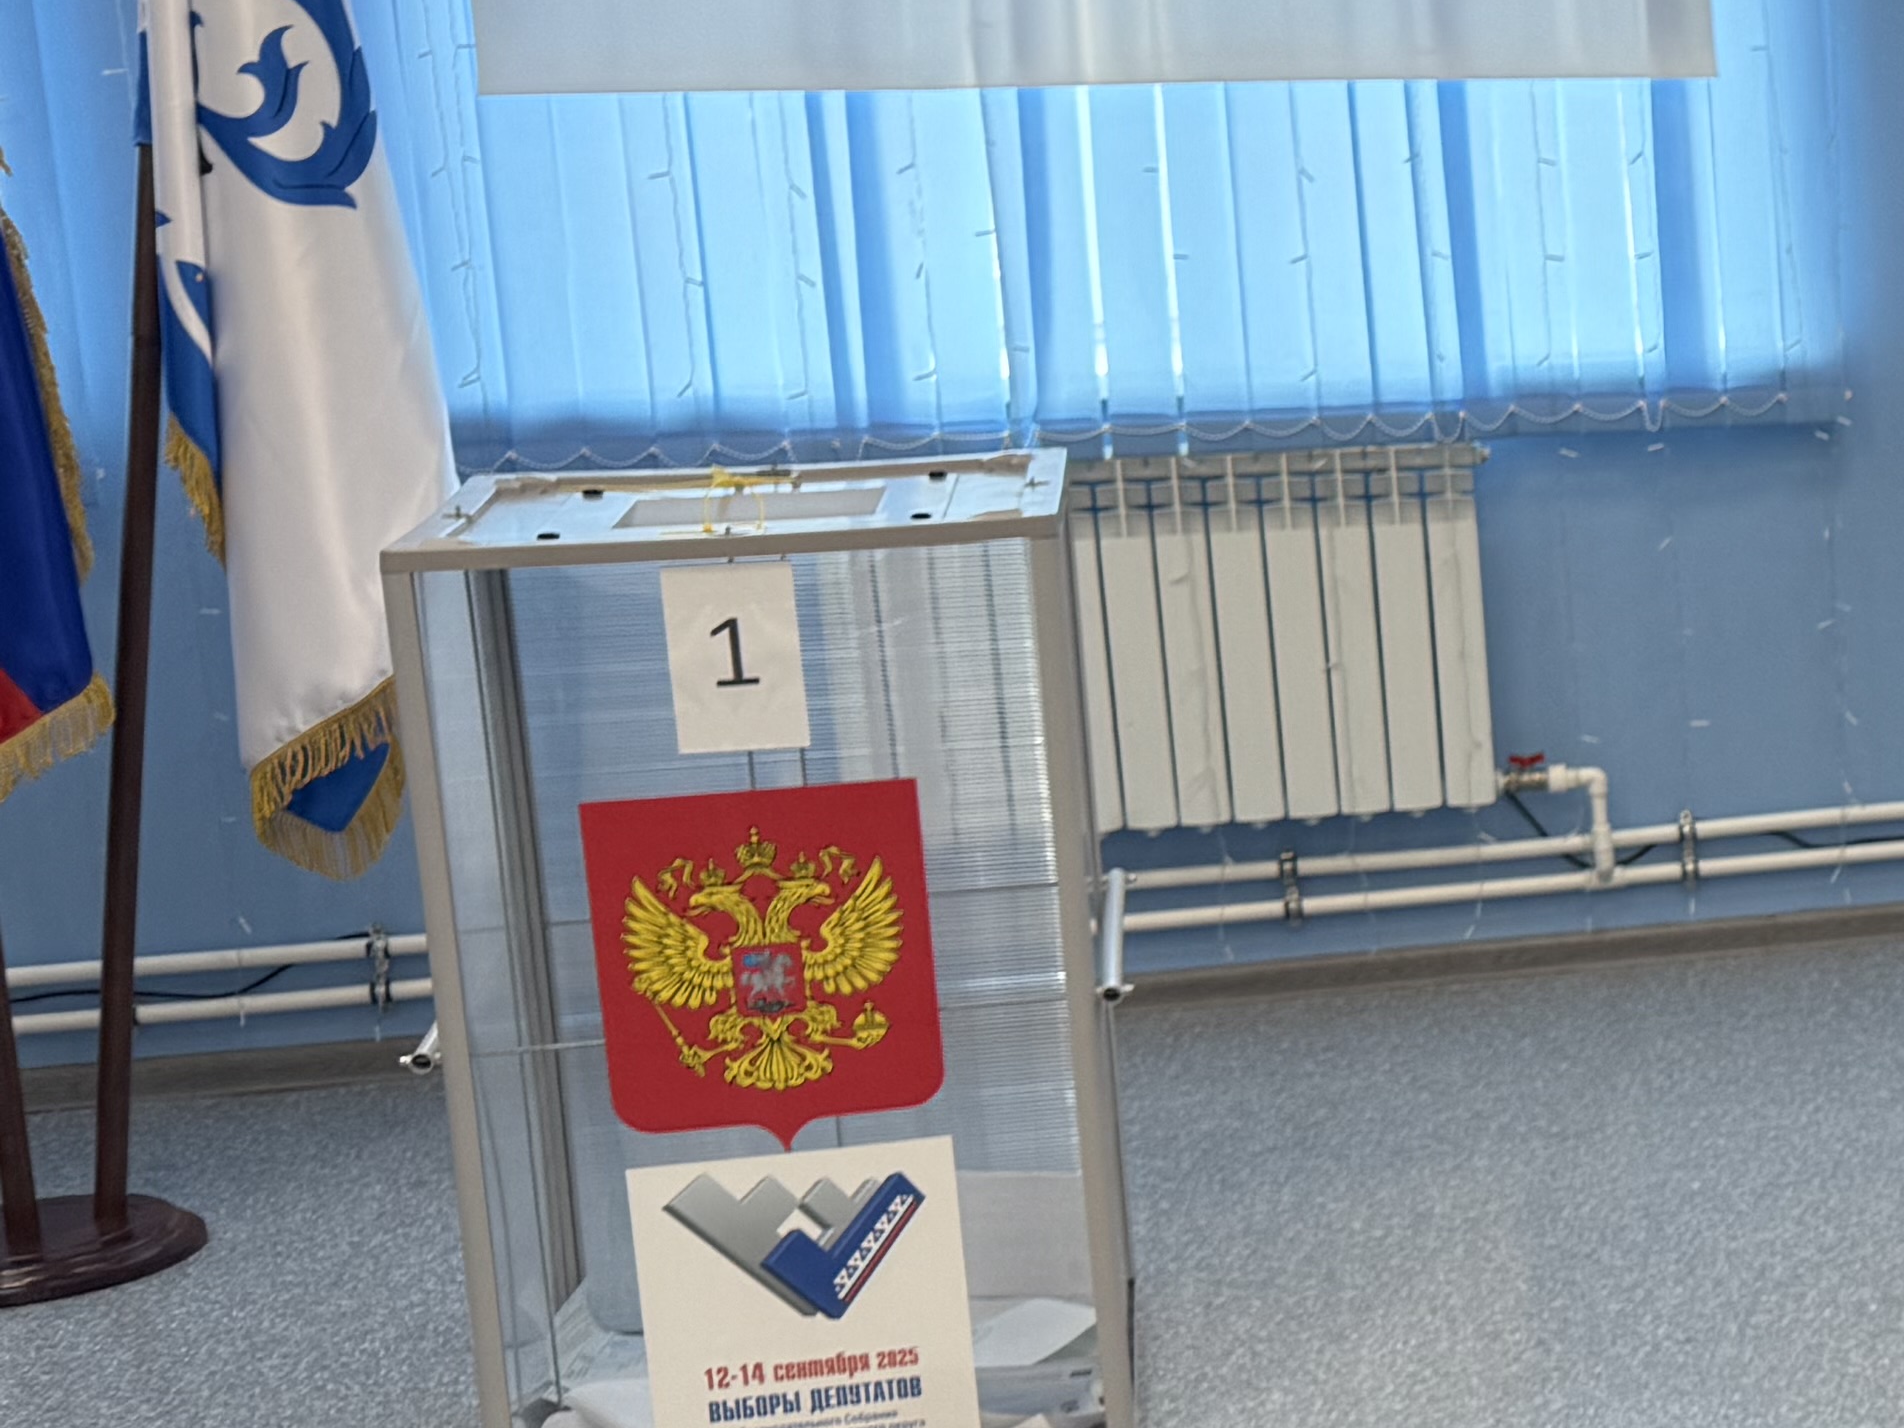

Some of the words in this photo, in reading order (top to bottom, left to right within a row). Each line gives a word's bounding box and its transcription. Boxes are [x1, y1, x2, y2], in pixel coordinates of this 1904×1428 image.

[710, 616, 760, 688] 1
[704, 1362, 765, 1391] 12-14
[773, 1351, 870, 1382] сентября
[876, 1346, 919, 1370] 2025
[708, 1390, 801, 1424] ВЫБОРЫ
[810, 1375, 922, 1414] ДЕПУТАТОВ
